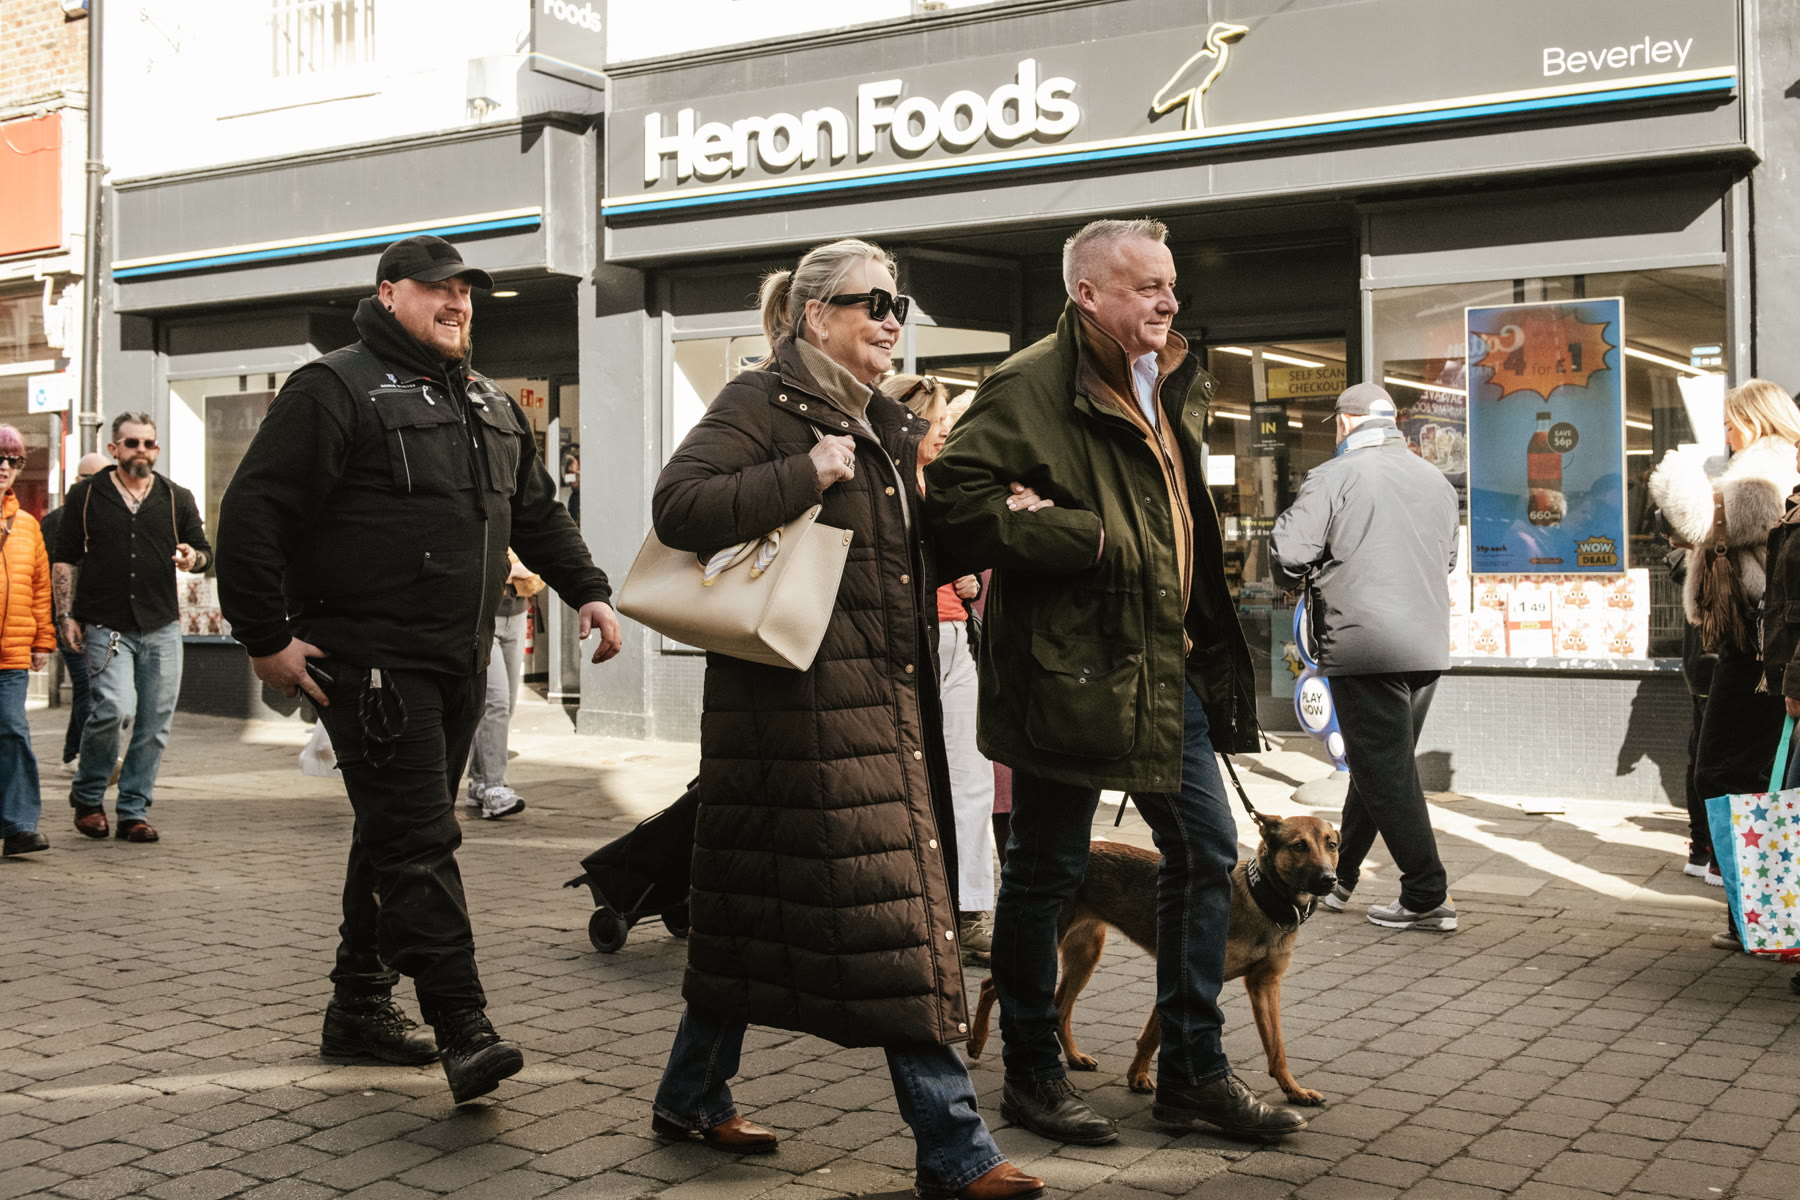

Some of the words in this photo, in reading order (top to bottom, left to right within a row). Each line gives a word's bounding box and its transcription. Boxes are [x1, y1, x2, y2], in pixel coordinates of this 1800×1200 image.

[1543, 36, 1693, 76] Beverley
[644, 107, 848, 181] Heron
[858, 58, 1080, 155] Foods
[1289, 369, 1313, 381] SELF
[1316, 367, 1345, 379] SCAN
[1532, 361, 1552, 375] for
[1288, 380, 1346, 393] CHECKOUT
[1261, 422, 1277, 434] IN
[1554, 437, 1572, 448] 56p
[1580, 543, 1612, 552] WOW
[1583, 555, 1611, 564] DEAL!
[1302, 692, 1323, 703] PLAY
[1303, 705, 1323, 716] NOW
